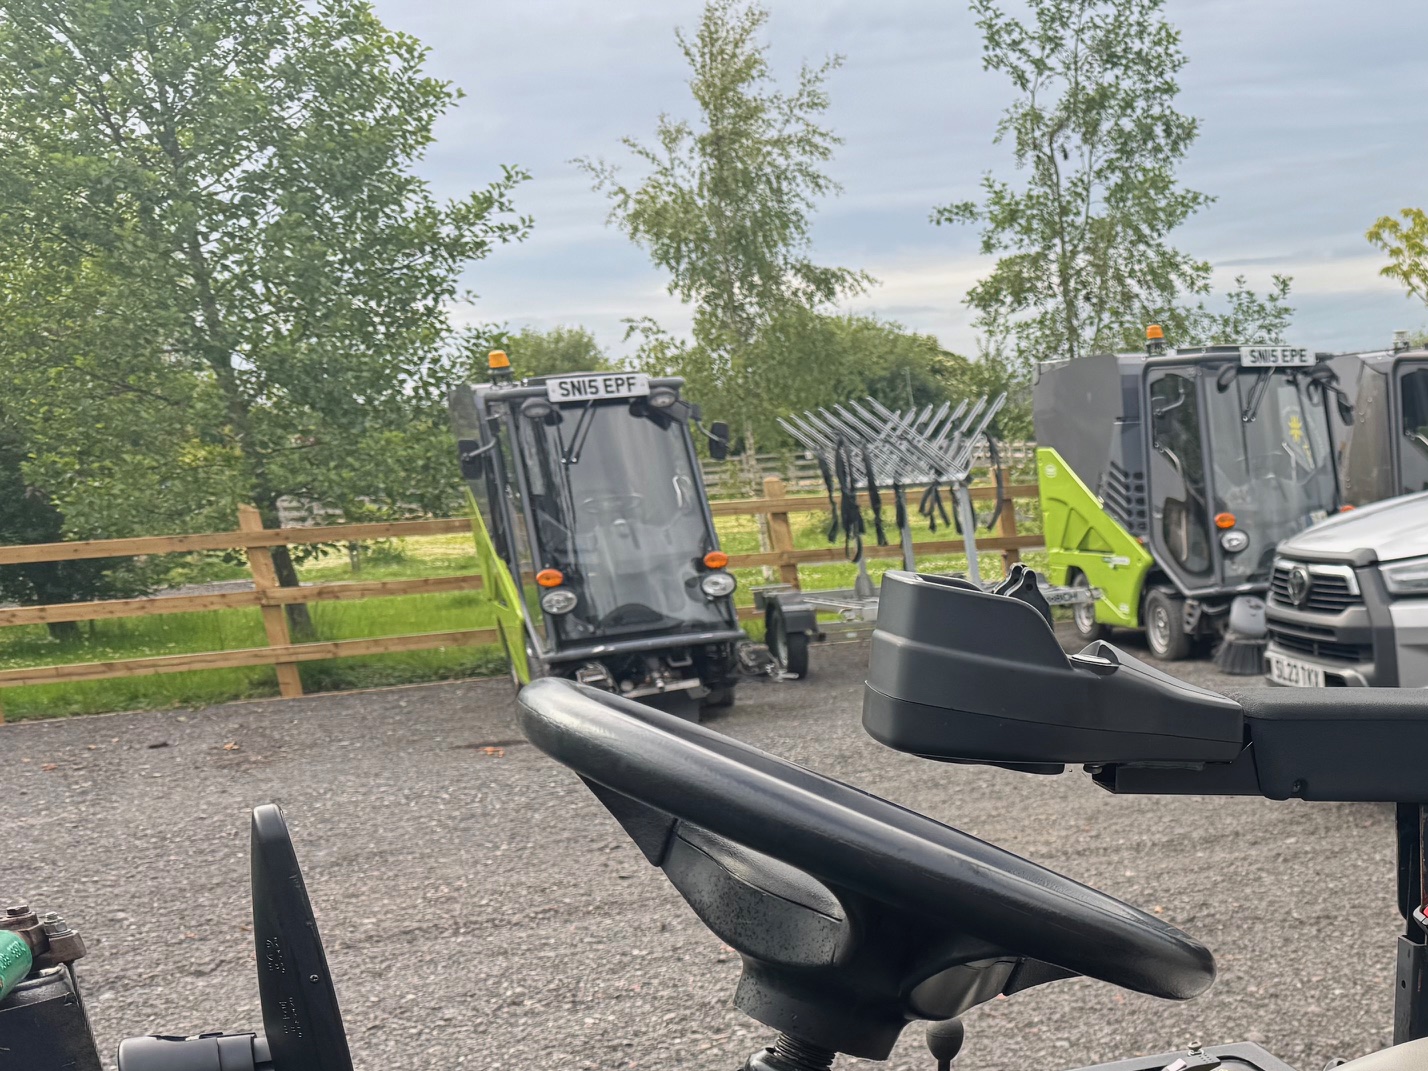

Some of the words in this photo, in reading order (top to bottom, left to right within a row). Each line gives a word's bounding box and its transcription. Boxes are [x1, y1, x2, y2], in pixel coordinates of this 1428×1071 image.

[1249, 348, 1278, 364] SN15
[559, 379, 599, 397] SN15
[603, 376, 636, 394] EPF
[1276, 660, 1300, 684] SL23
